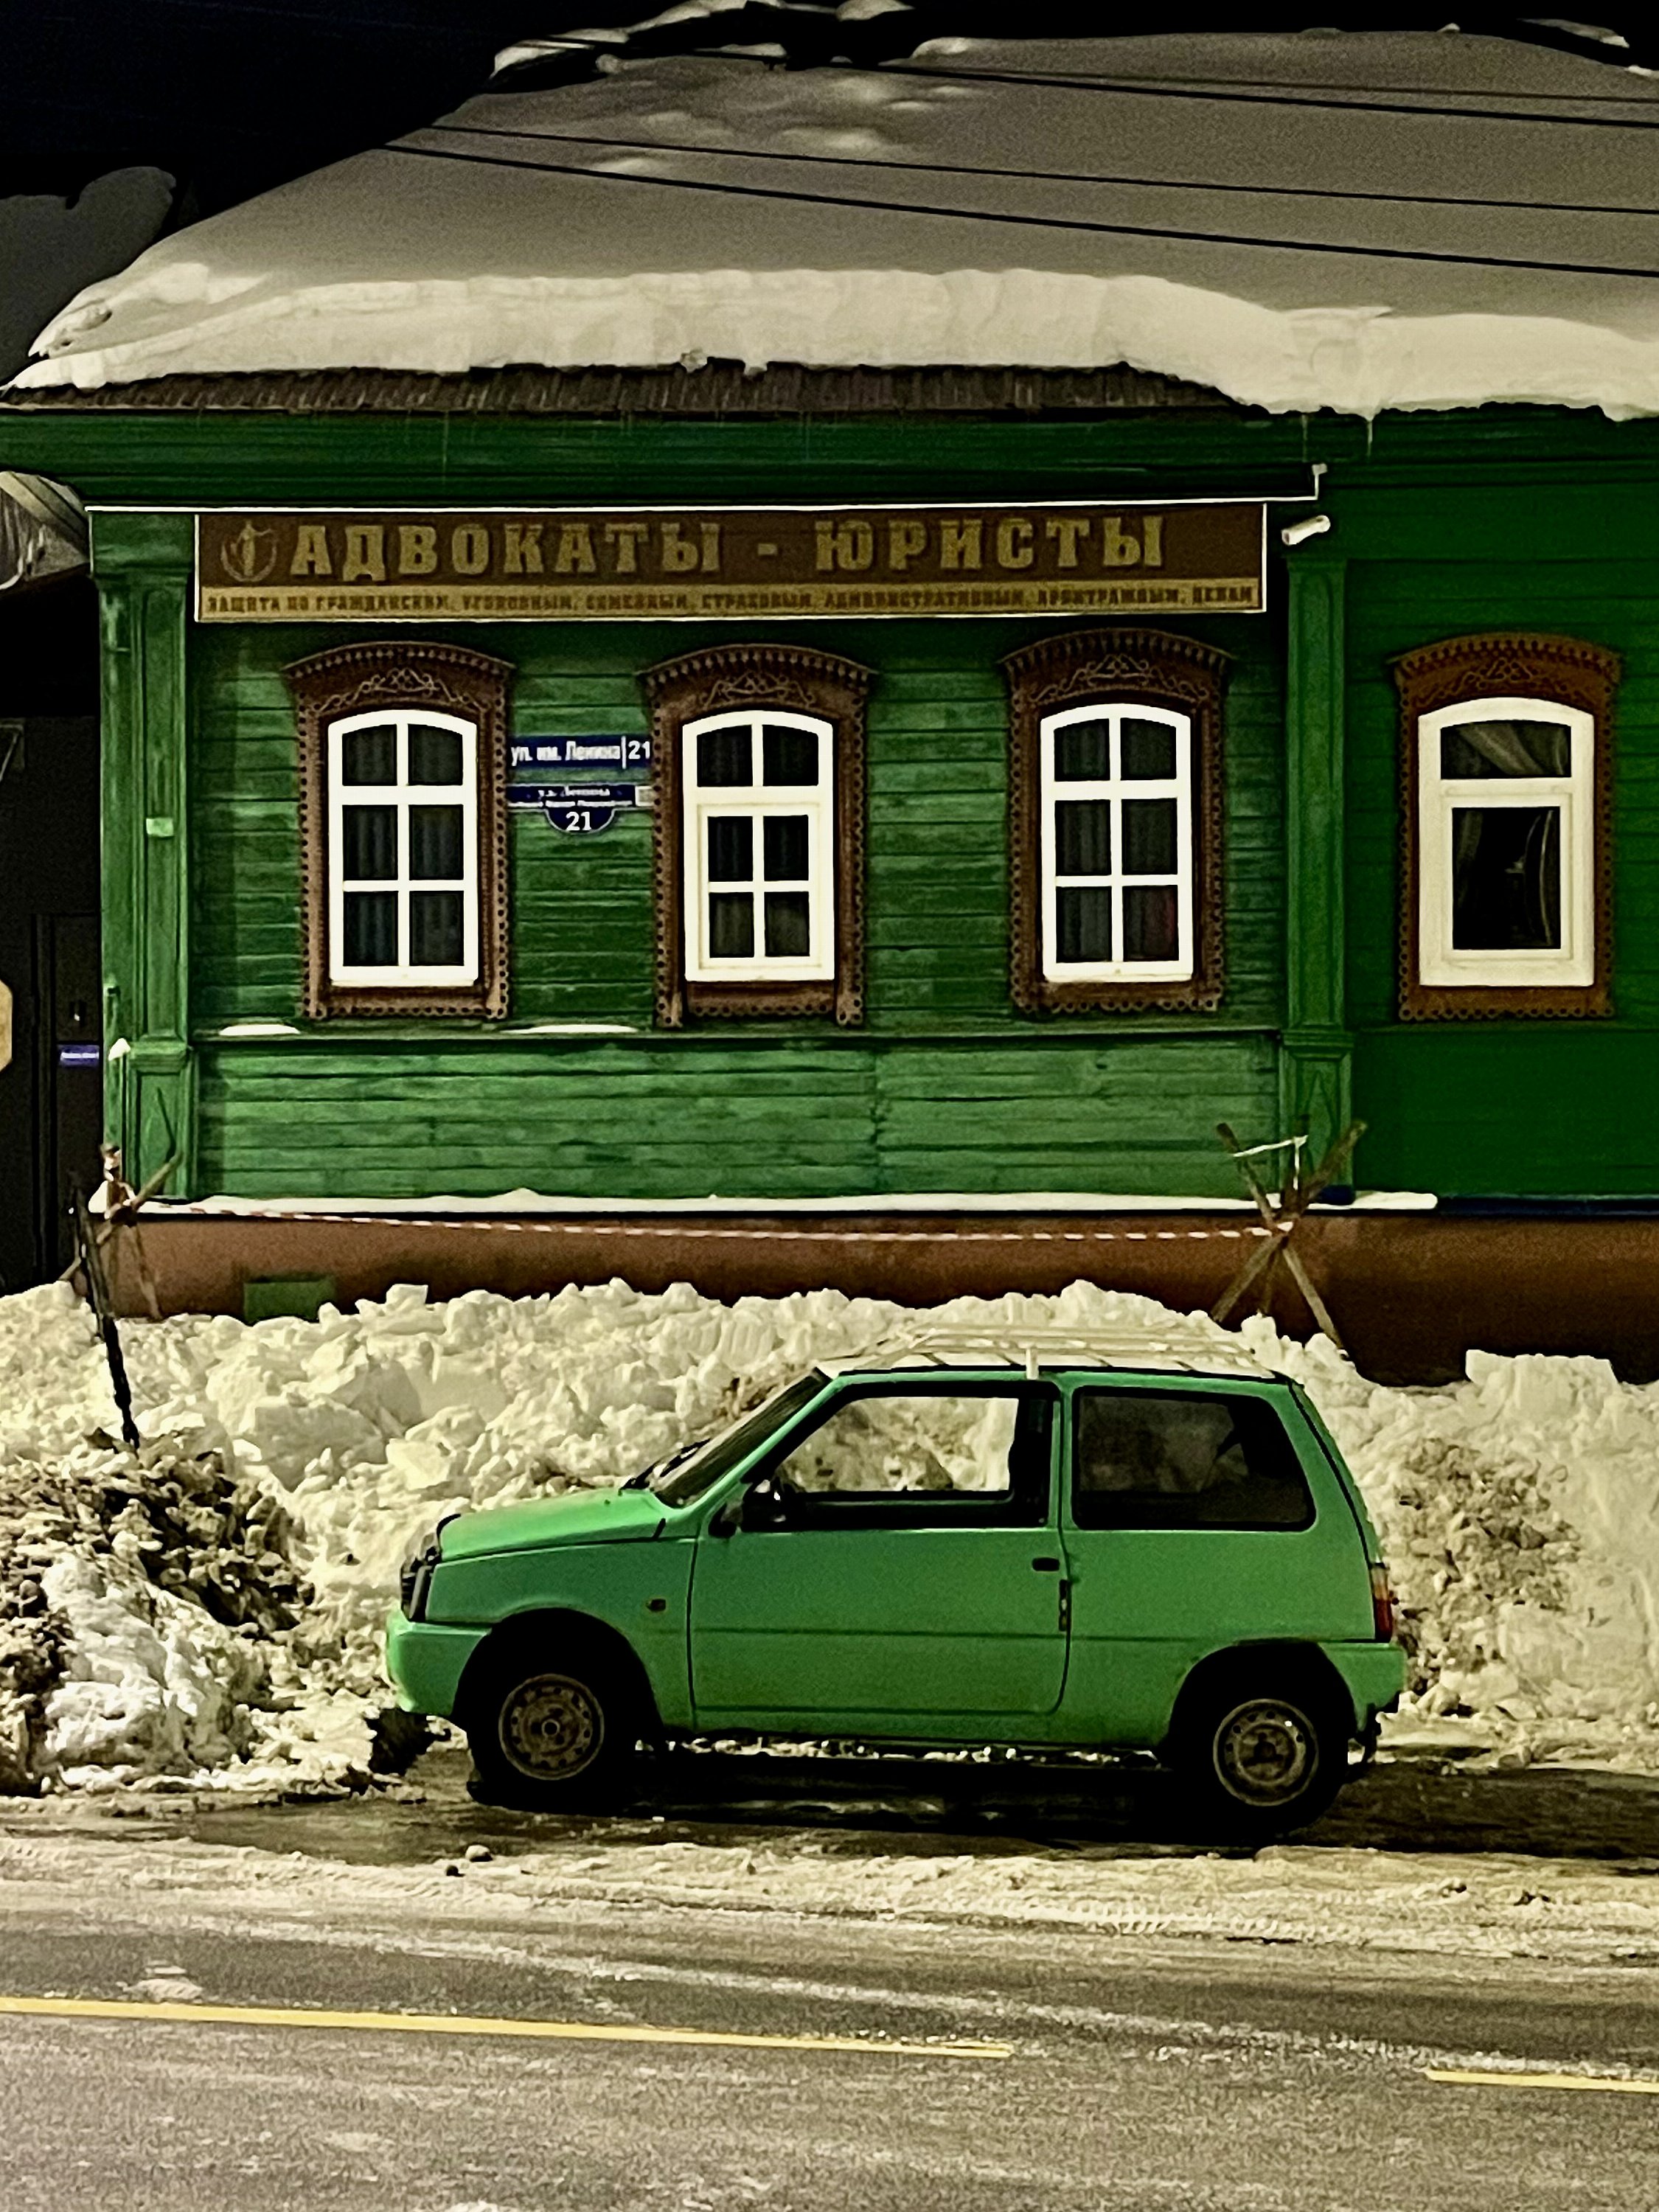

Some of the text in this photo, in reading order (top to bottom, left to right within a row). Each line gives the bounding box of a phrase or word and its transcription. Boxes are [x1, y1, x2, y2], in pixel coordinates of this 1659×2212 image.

[291, 523, 720, 581] АДВОКАТЫ
[816, 517, 1163, 571] ЮРИСТЫ
[208, 596, 280, 612] ЗАЩИТА
[511, 746, 532, 766] ул.
[628, 740, 650, 759] 21
[566, 811, 591, 831] 21
